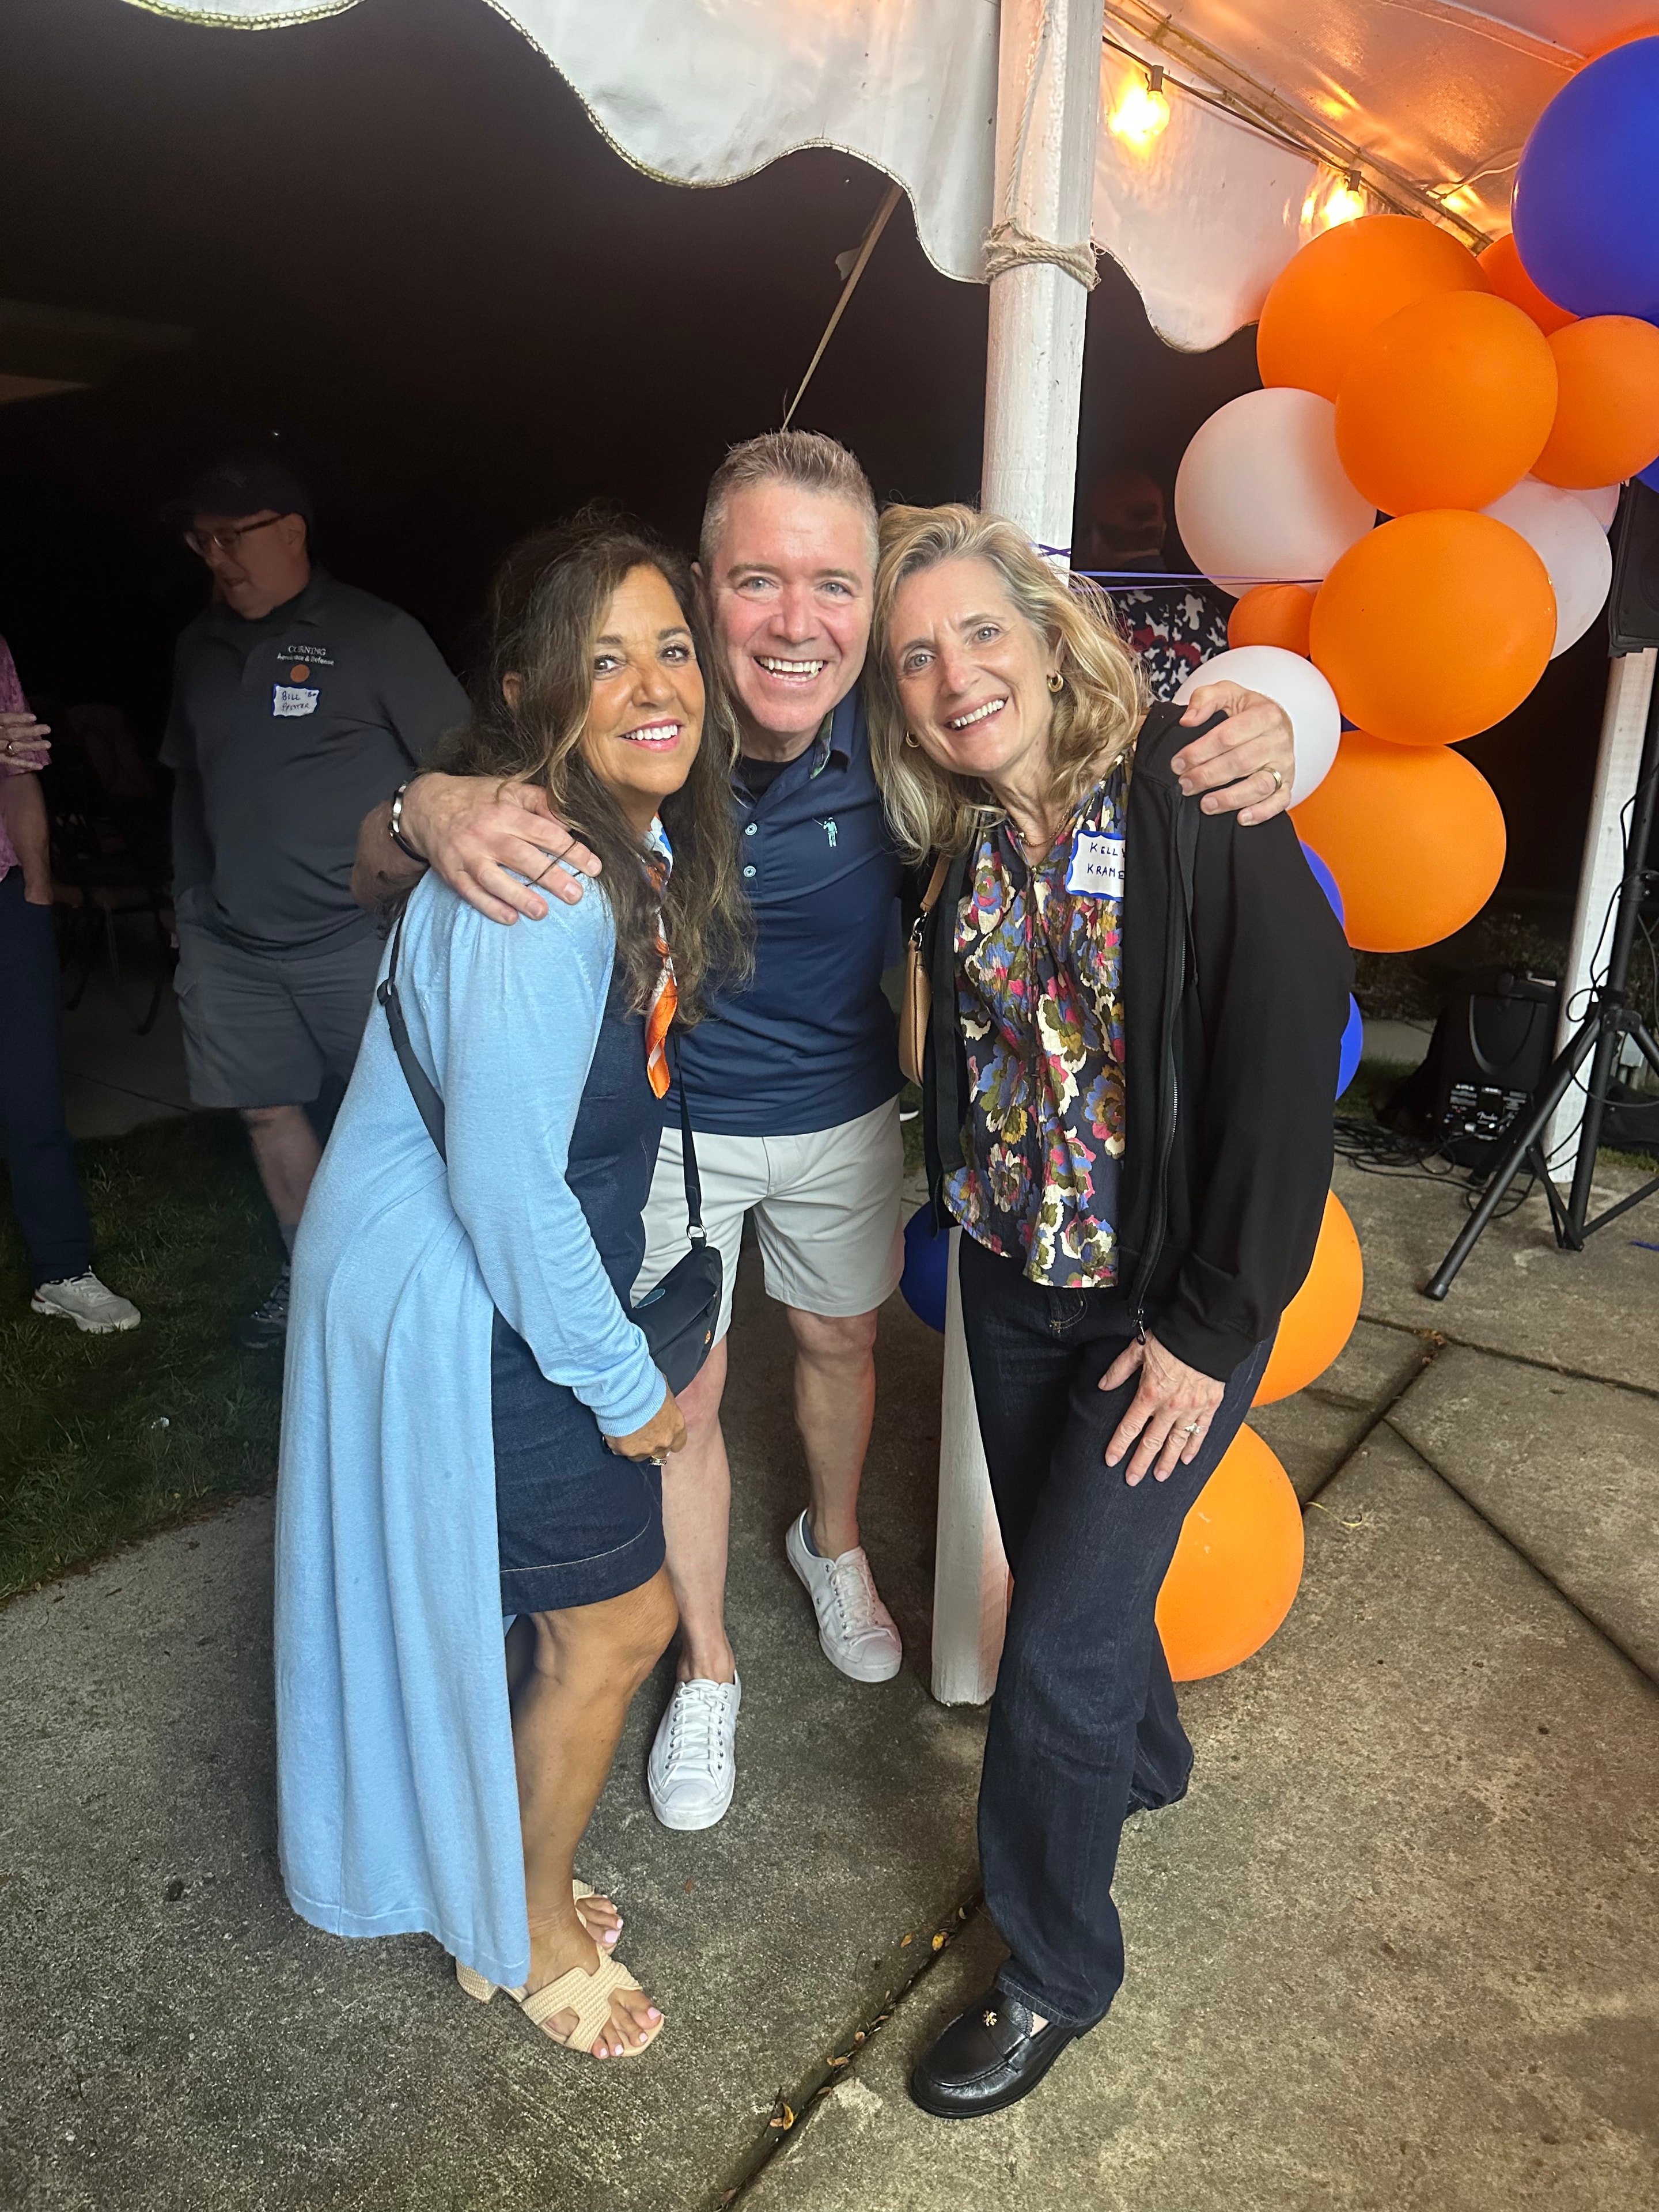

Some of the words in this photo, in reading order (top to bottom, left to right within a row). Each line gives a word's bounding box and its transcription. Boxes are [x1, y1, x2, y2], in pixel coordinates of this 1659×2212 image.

[288, 645, 326, 656] CORNING
[310, 656, 334, 665] Defense
[282, 691, 301, 700] BILL
[1087, 863, 1124, 880] KRAME
